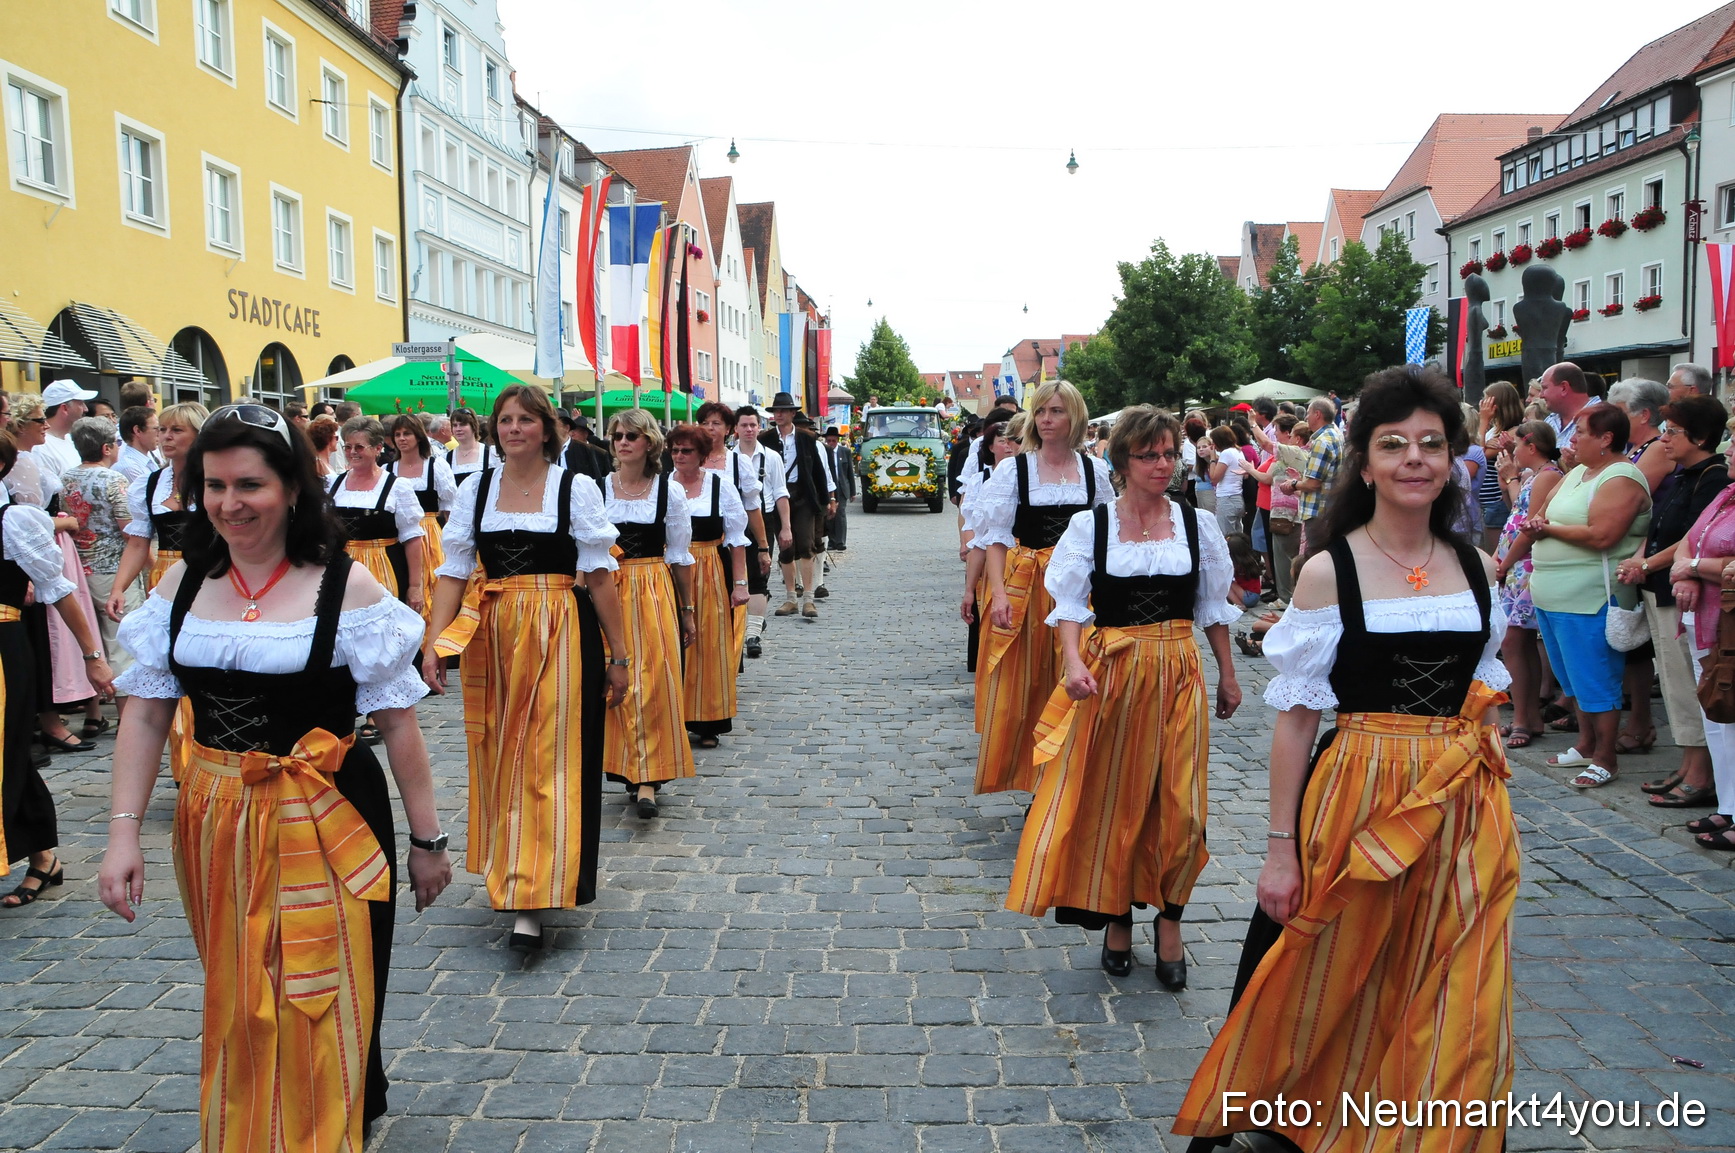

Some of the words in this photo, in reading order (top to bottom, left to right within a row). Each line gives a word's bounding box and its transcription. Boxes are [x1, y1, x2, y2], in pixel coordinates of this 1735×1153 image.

[1689, 209, 1699, 239] Achatz
[228, 288, 320, 337] STADTCAFE
[395, 344, 442, 355] Klostergasse
[409, 379, 493, 388] Lammbräu
